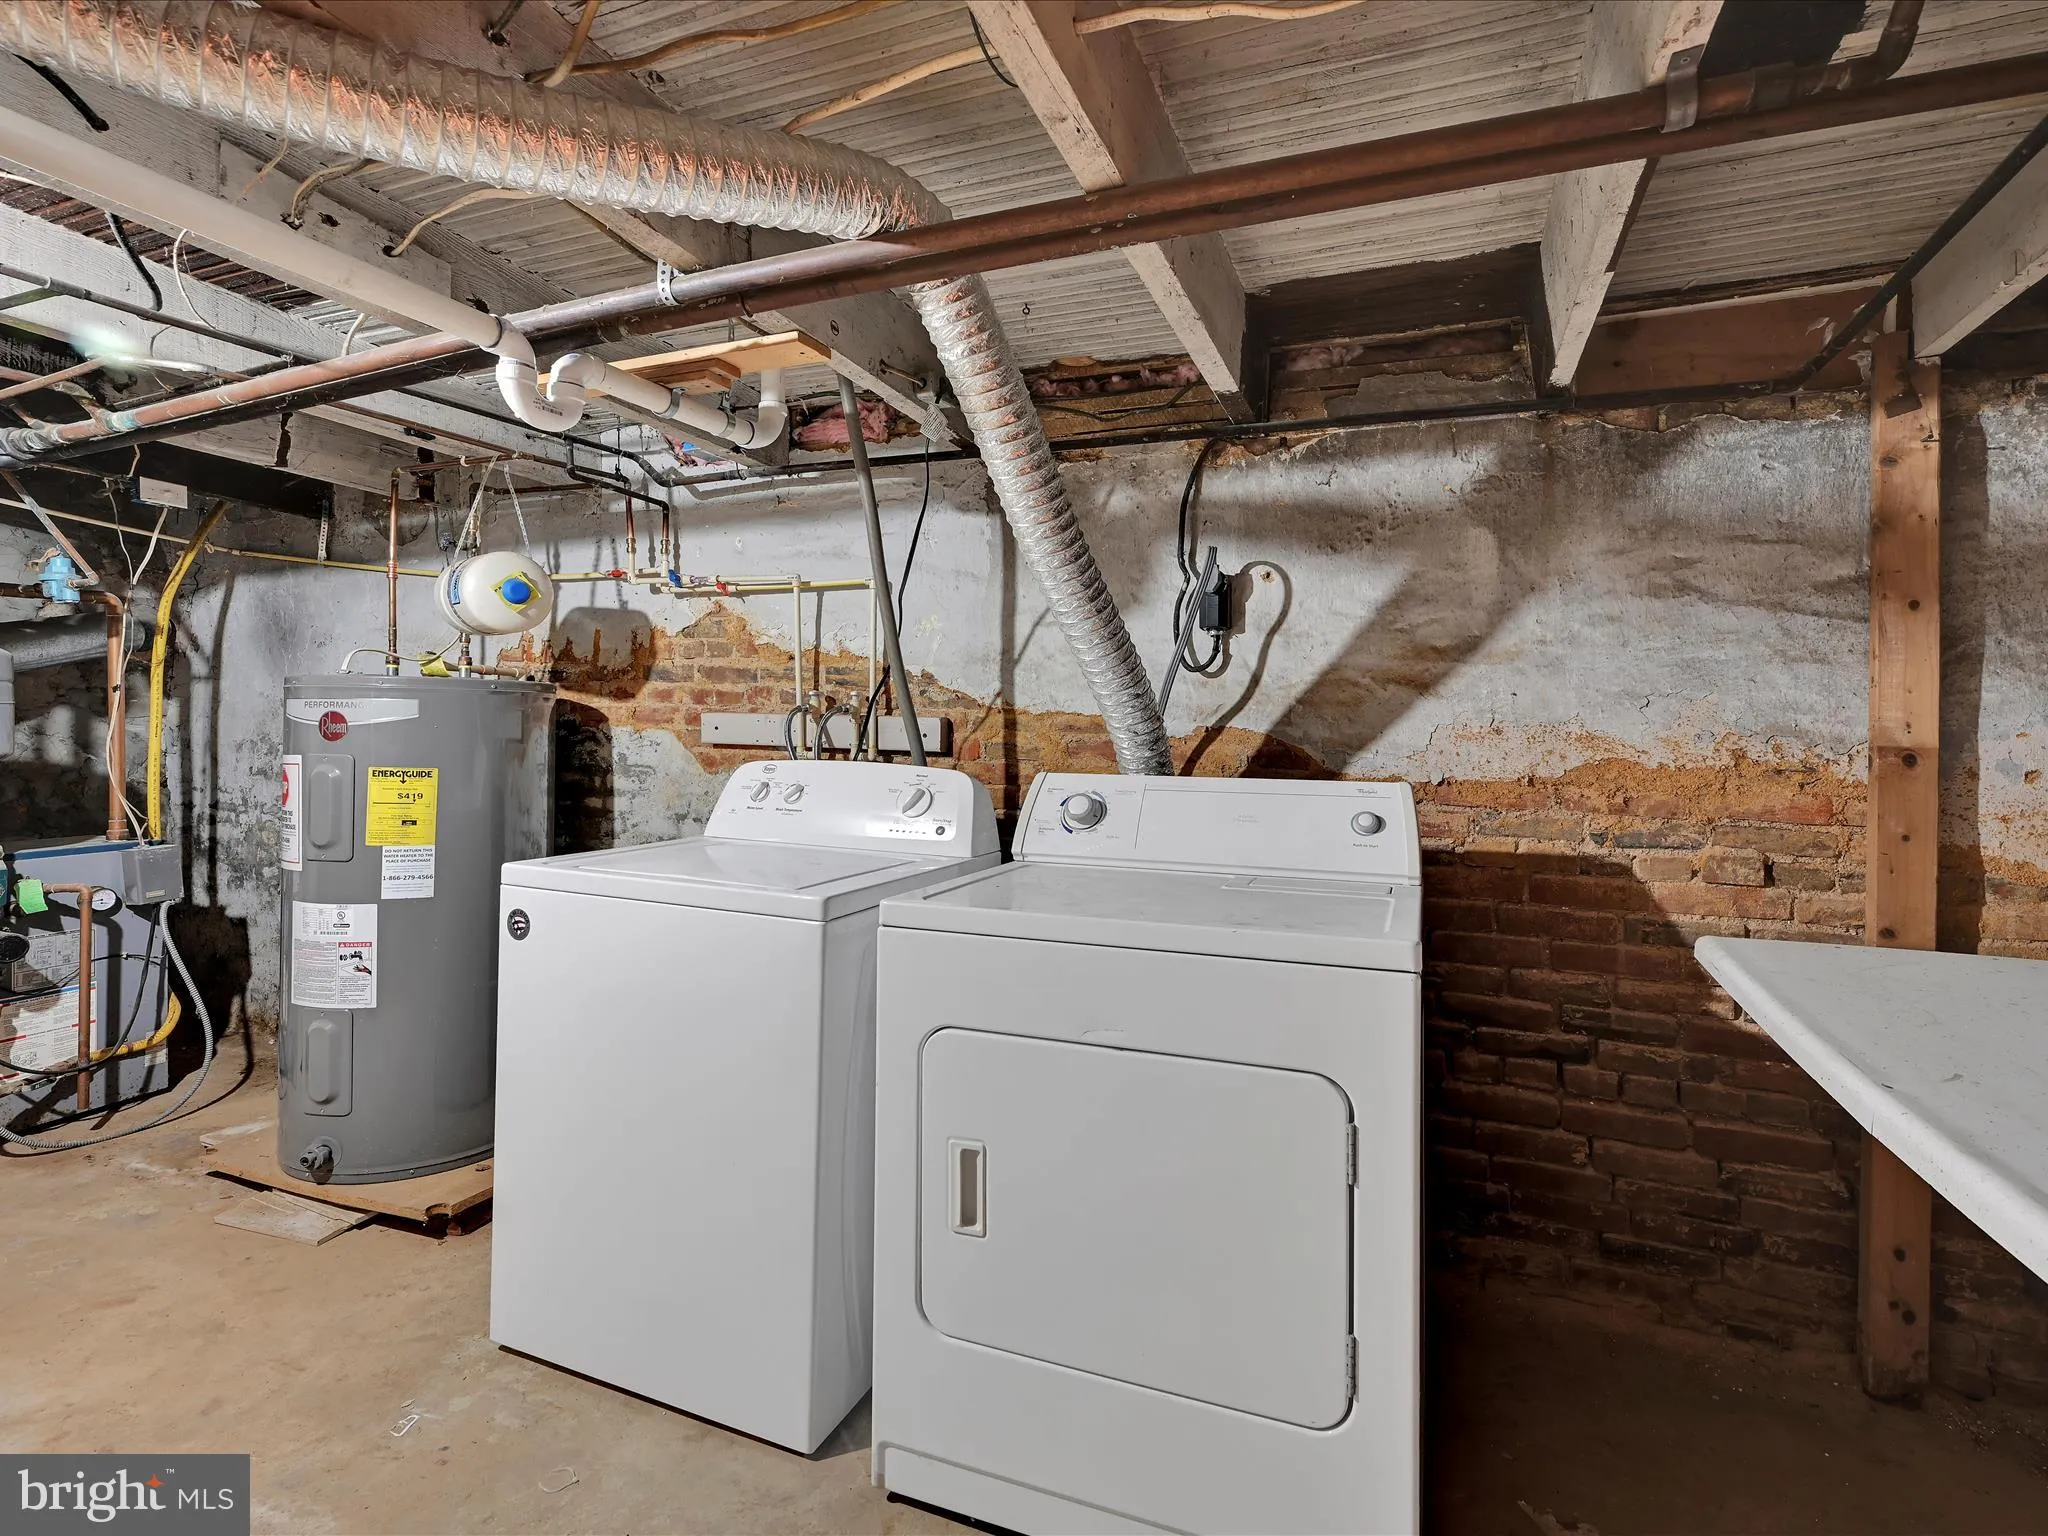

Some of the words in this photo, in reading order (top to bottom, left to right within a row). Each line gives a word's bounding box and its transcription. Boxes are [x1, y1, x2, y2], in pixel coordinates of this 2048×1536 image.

[304, 701, 367, 709] PERFORMAN
[321, 711, 347, 737] Rheem
[372, 769, 433, 779] ENERGYGUIDE
